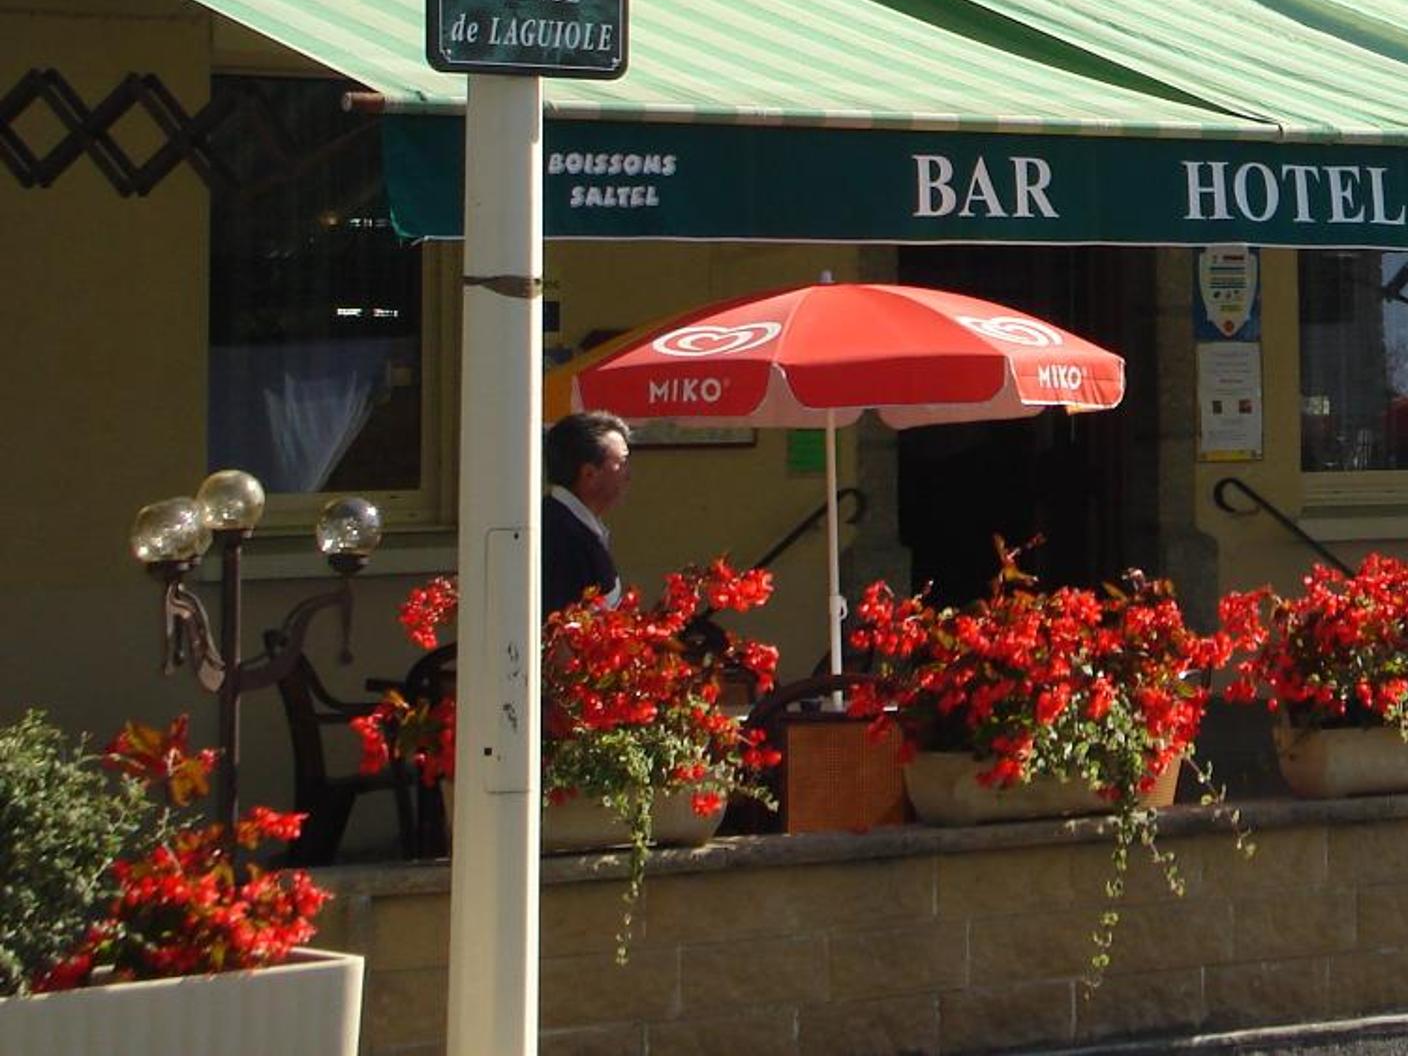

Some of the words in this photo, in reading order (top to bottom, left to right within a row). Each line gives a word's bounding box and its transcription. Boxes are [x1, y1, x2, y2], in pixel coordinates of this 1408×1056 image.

[451, 13, 479, 43] de
[489, 16, 613, 51] LAGUIOLE
[547, 152, 677, 176] BOISSONS
[569, 185, 660, 208] SALTEL
[912, 154, 1060, 220] BAR
[1181, 160, 1407, 227] HOTEL
[1038, 363, 1083, 390] MIKO
[649, 377, 722, 404] MIKO
